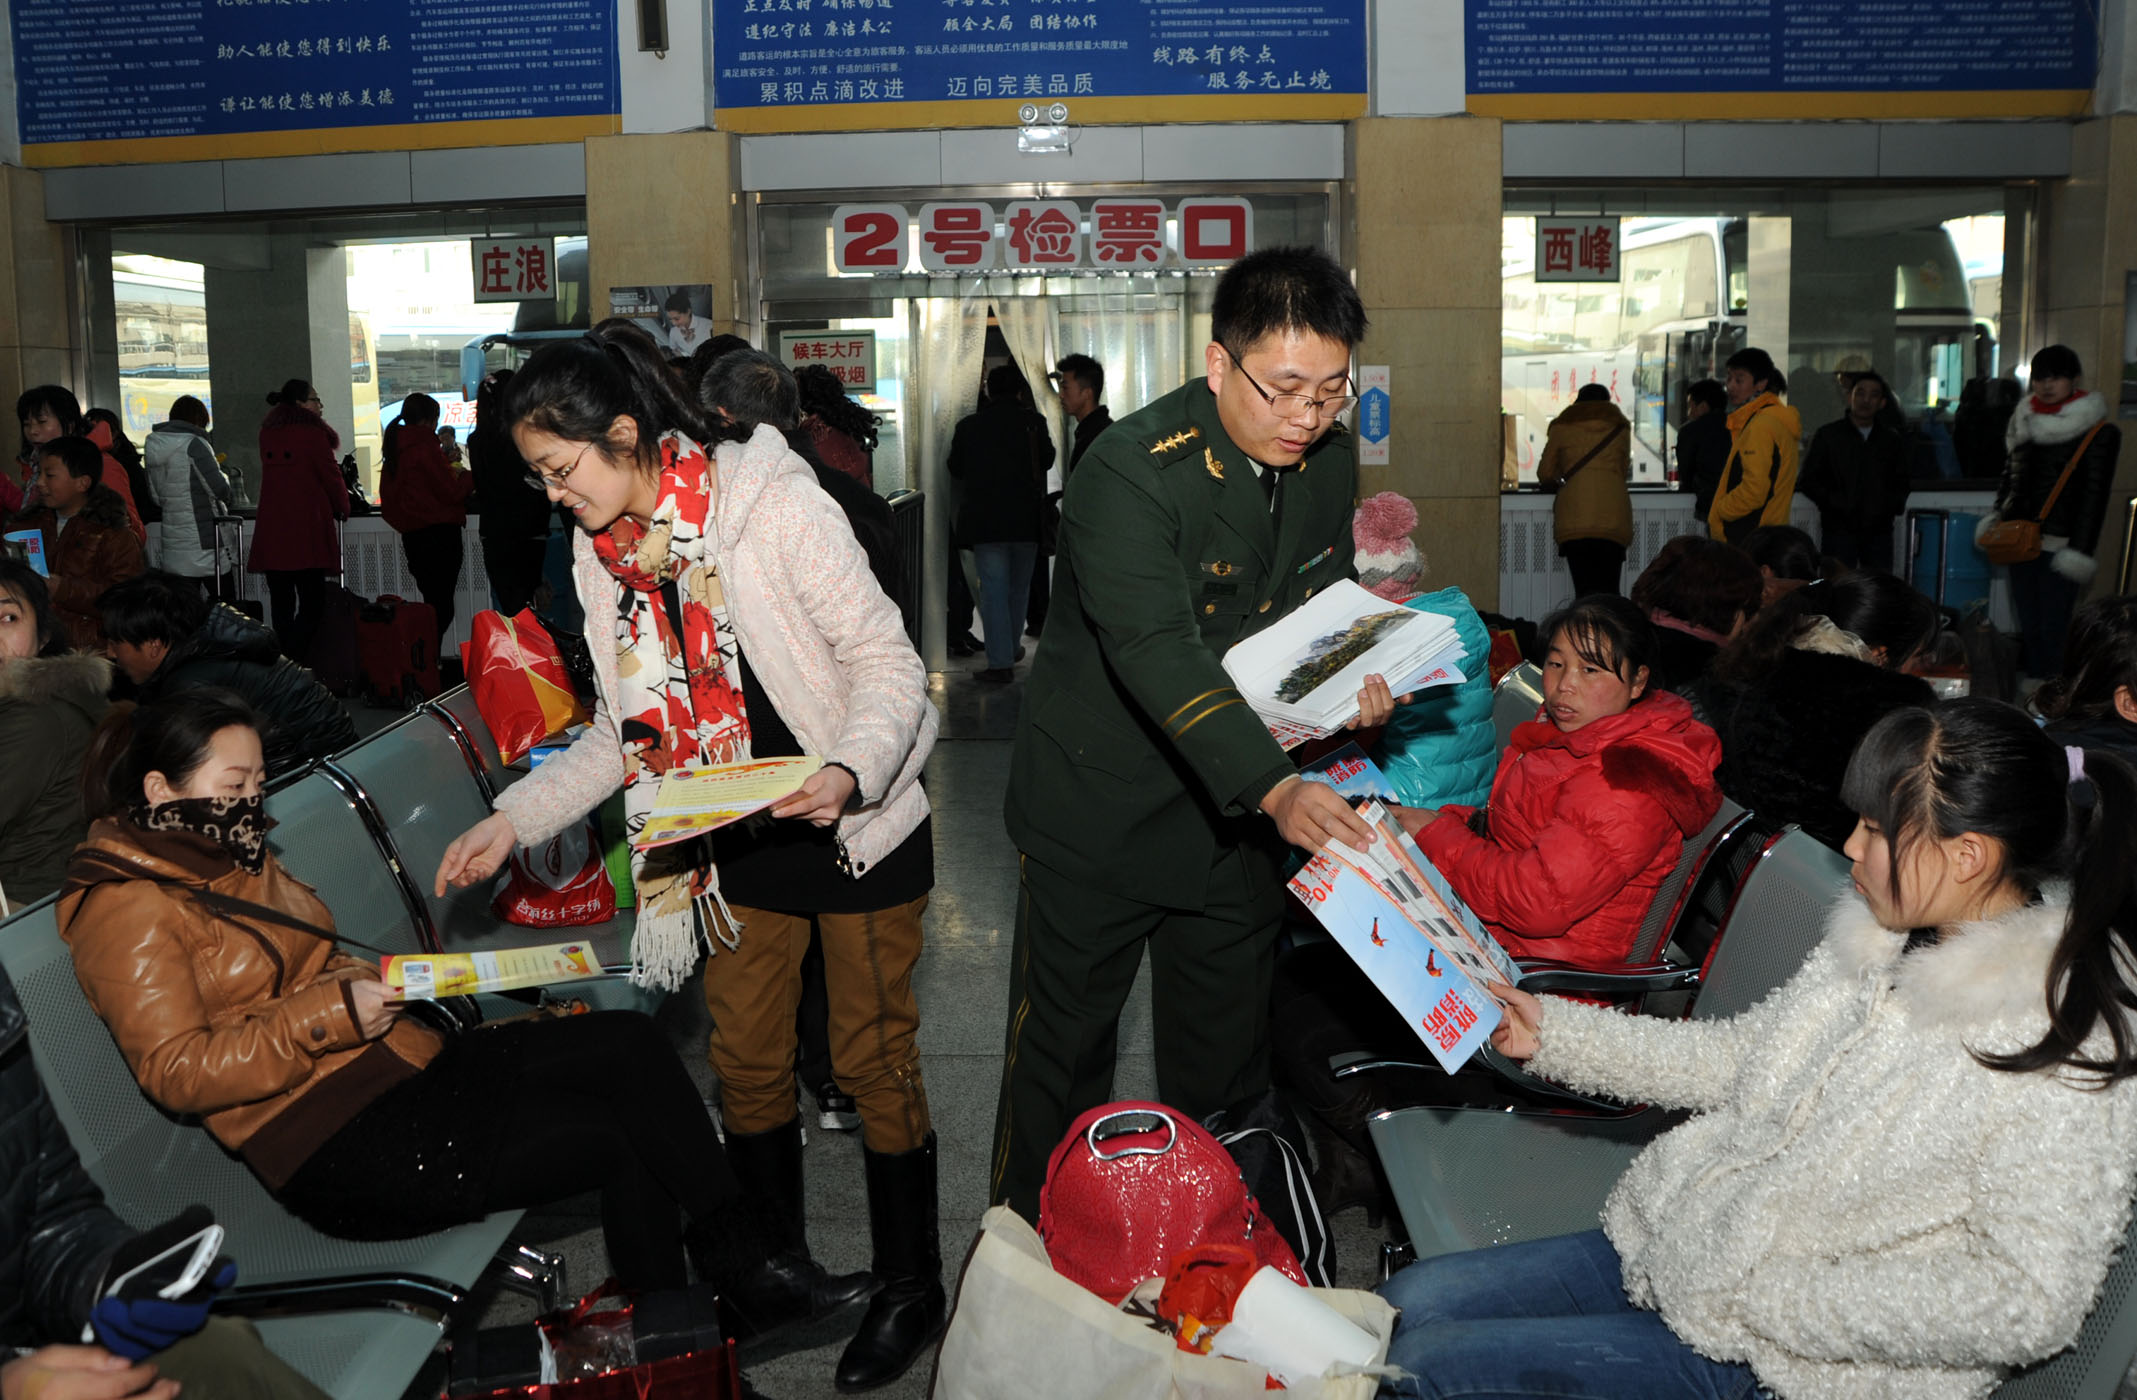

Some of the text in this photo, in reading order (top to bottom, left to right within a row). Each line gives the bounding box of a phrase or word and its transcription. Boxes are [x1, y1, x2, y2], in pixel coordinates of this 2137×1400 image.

[744, 17, 892, 40] 遵纪守法 廉洁奉公
[1029, 13, 1098, 30] 团结协作
[217, 34, 392, 59] 助人能使您得到快乐
[1153, 44, 1276, 66] 线路有终点
[760, 78, 904, 103] 累积点滴改进
[947, 72, 1094, 97] 迈向完美品质
[1207, 68, 1333, 90] 服务无止境
[219, 87, 395, 112] 谦让能使您增添美德
[844, 205, 1246, 267] 2号检票口
[1542, 225, 1613, 275] 西峰
[480, 245, 549, 294] 庄浪
[792, 341, 864, 360] 候车大厅
[1422, 988, 1461, 1037] 消防
[1439, 1003, 1479, 1054] 陇原
